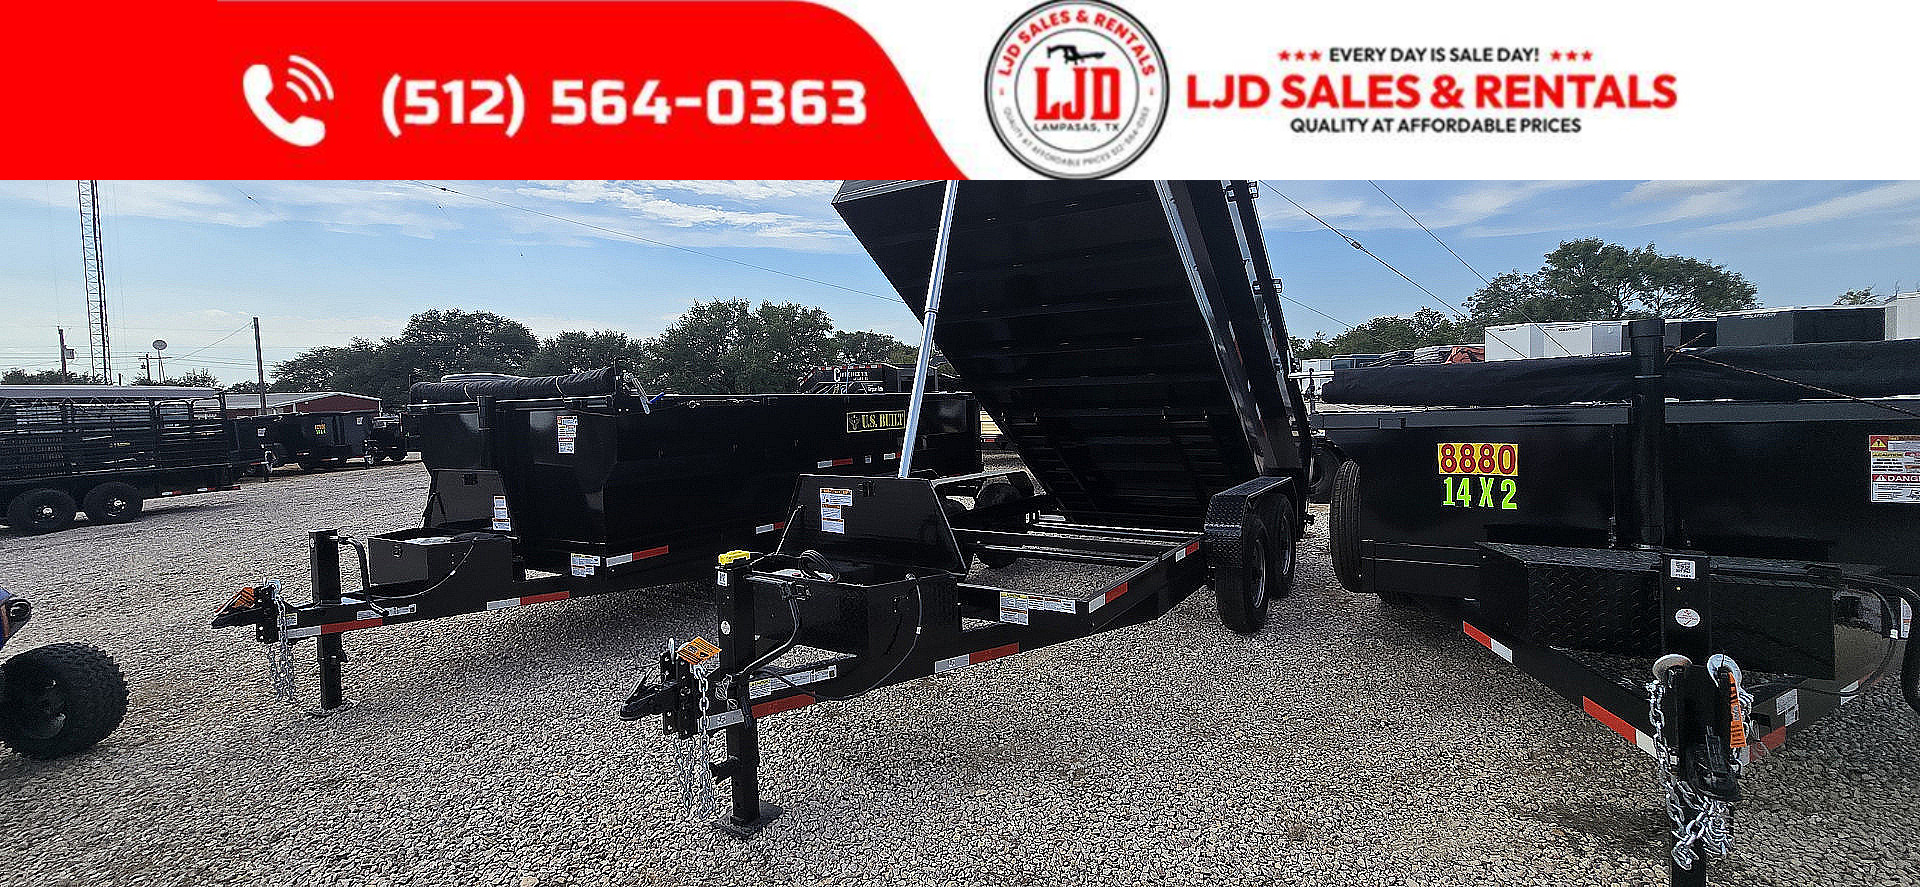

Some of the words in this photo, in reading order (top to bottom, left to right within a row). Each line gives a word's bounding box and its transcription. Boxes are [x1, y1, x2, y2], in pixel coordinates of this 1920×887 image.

[861, 414, 879, 429] U.S.
[879, 413, 904, 428] BUILT
[1440, 443, 1518, 475] 8880
[1442, 478, 1472, 508] 14
[1478, 476, 1495, 508] X
[1500, 479, 1519, 510] 2
